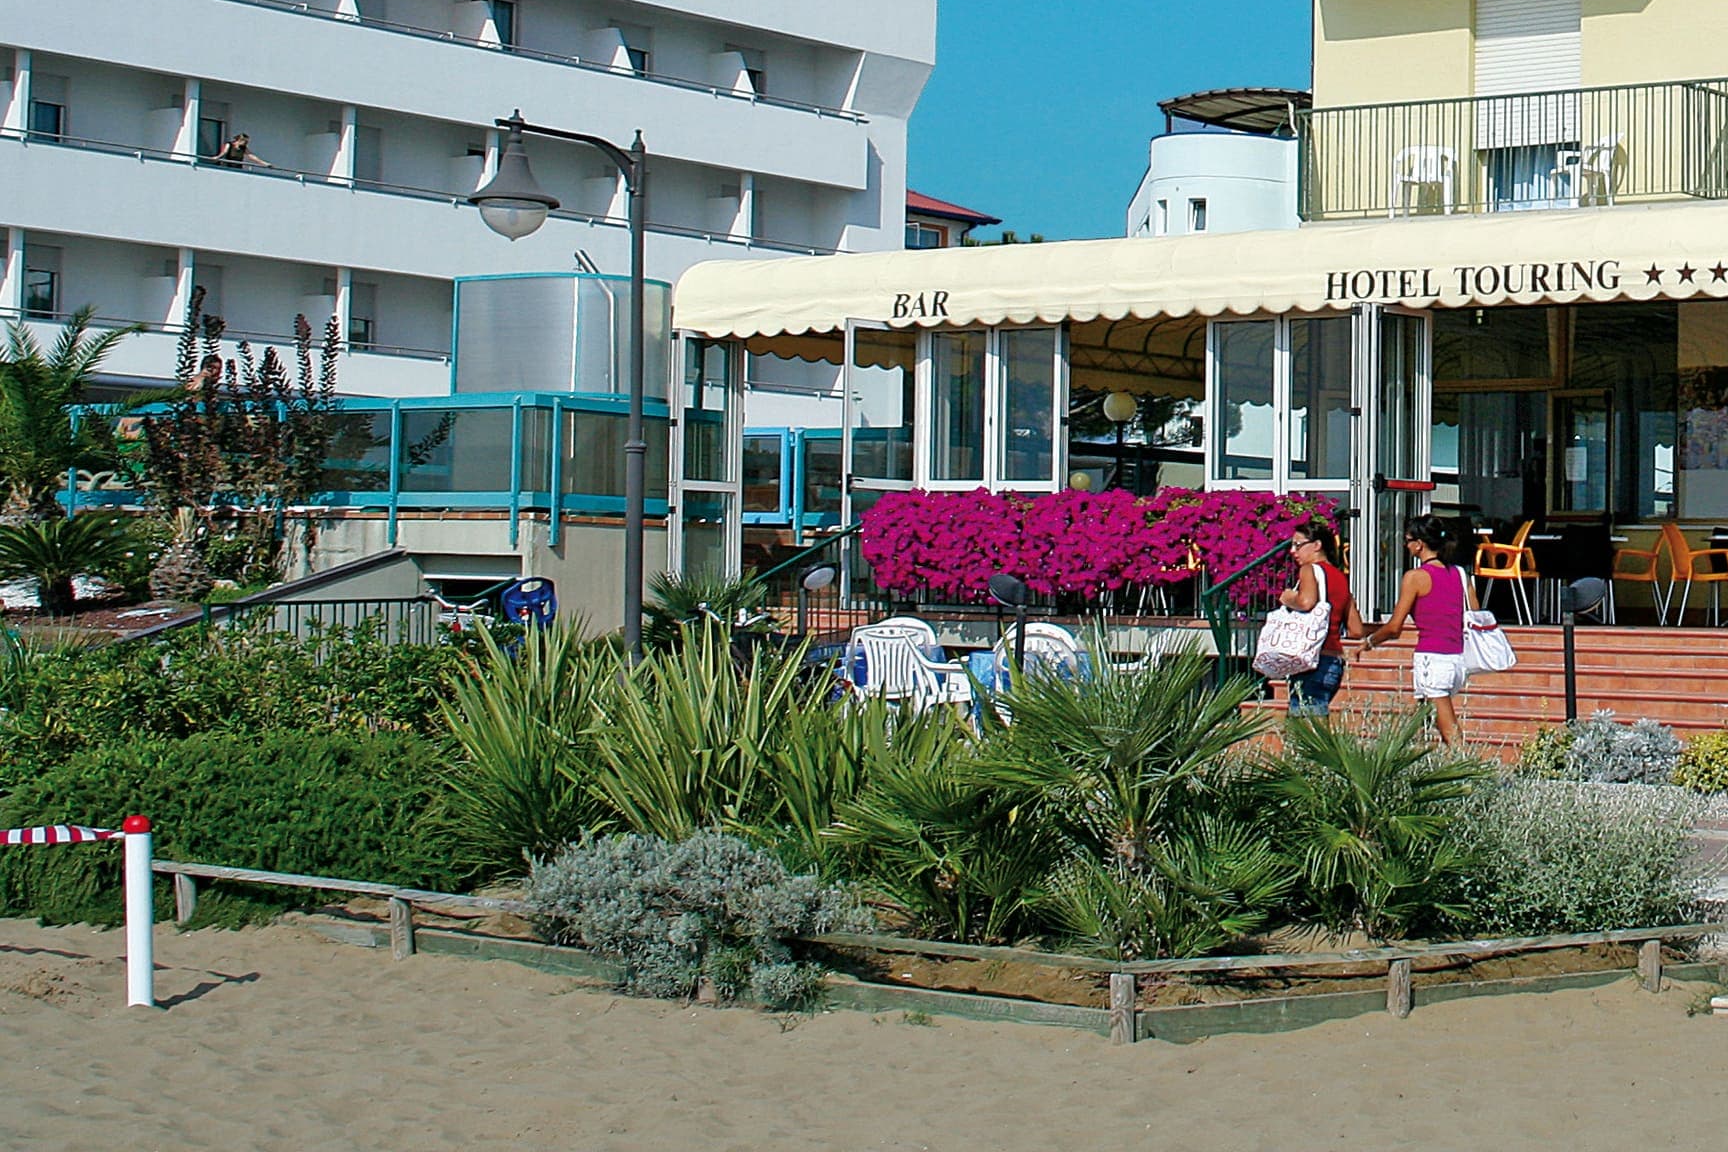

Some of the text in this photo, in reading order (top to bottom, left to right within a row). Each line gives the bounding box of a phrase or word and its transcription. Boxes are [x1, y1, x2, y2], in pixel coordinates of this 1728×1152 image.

[1324, 260, 1622, 301] HOTEL TOURING
[891, 290, 950, 319] BAR
